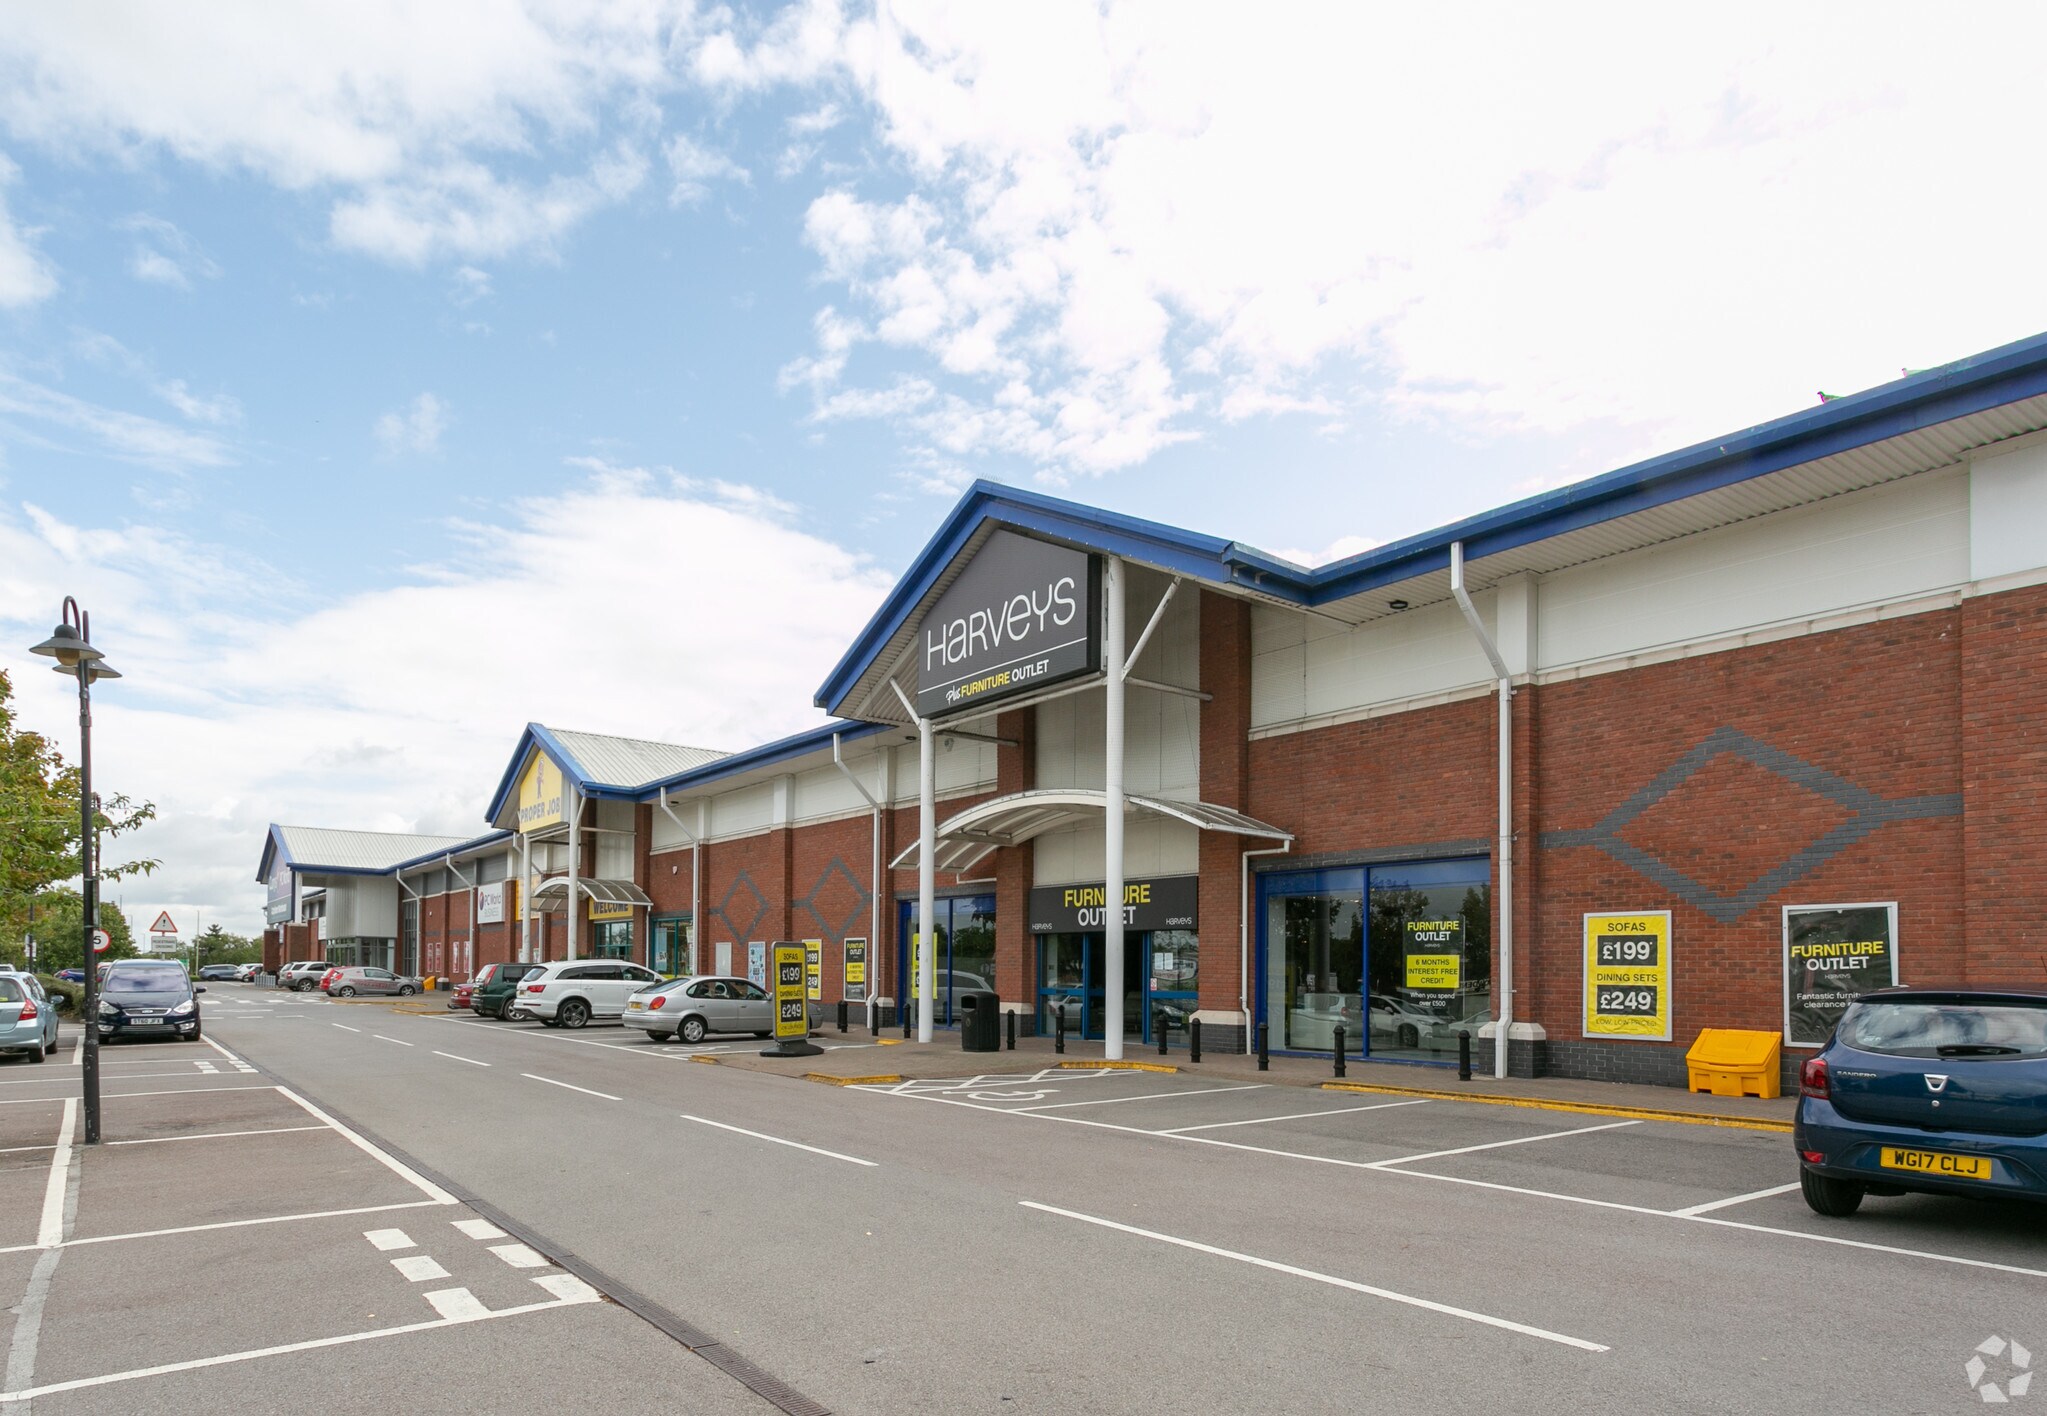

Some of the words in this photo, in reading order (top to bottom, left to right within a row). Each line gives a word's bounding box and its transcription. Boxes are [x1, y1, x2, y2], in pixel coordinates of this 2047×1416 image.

[960, 671, 1011, 698] FURNITURE
[1011, 659, 1050, 682] OUTLET
[520, 802, 545, 823] PROPER
[547, 797, 561, 816] JOB
[1064, 884, 1151, 908] FURNURE
[594, 901, 629, 914] WELCOME
[1077, 906, 1137, 926] OUTET
[1407, 921, 1460, 931] FURNITURE
[1607, 922, 1646, 932] SOFAS
[93, 936, 102, 945] 5
[1415, 931, 1451, 941] OUTLET
[1791, 941, 1885, 958] FURNITURE
[1806, 956, 1870, 971] OUTLET
[782, 967, 800, 981] £199
[1596, 973, 1631, 982] DINING
[1633, 974, 1658, 982] SETS
[1438, 992, 1456, 1000] spend
[1796, 992, 1835, 1000] Fantastic
[1836, 992, 1861, 1000] furnit
[782, 1004, 802, 1018] £249
[1804, 1001, 1846, 1009] clearance
[1837, 1070, 1877, 1079] SANDERO
[1894, 1150, 1935, 1168] WG17
[1940, 1156, 1979, 1174] CLJ
